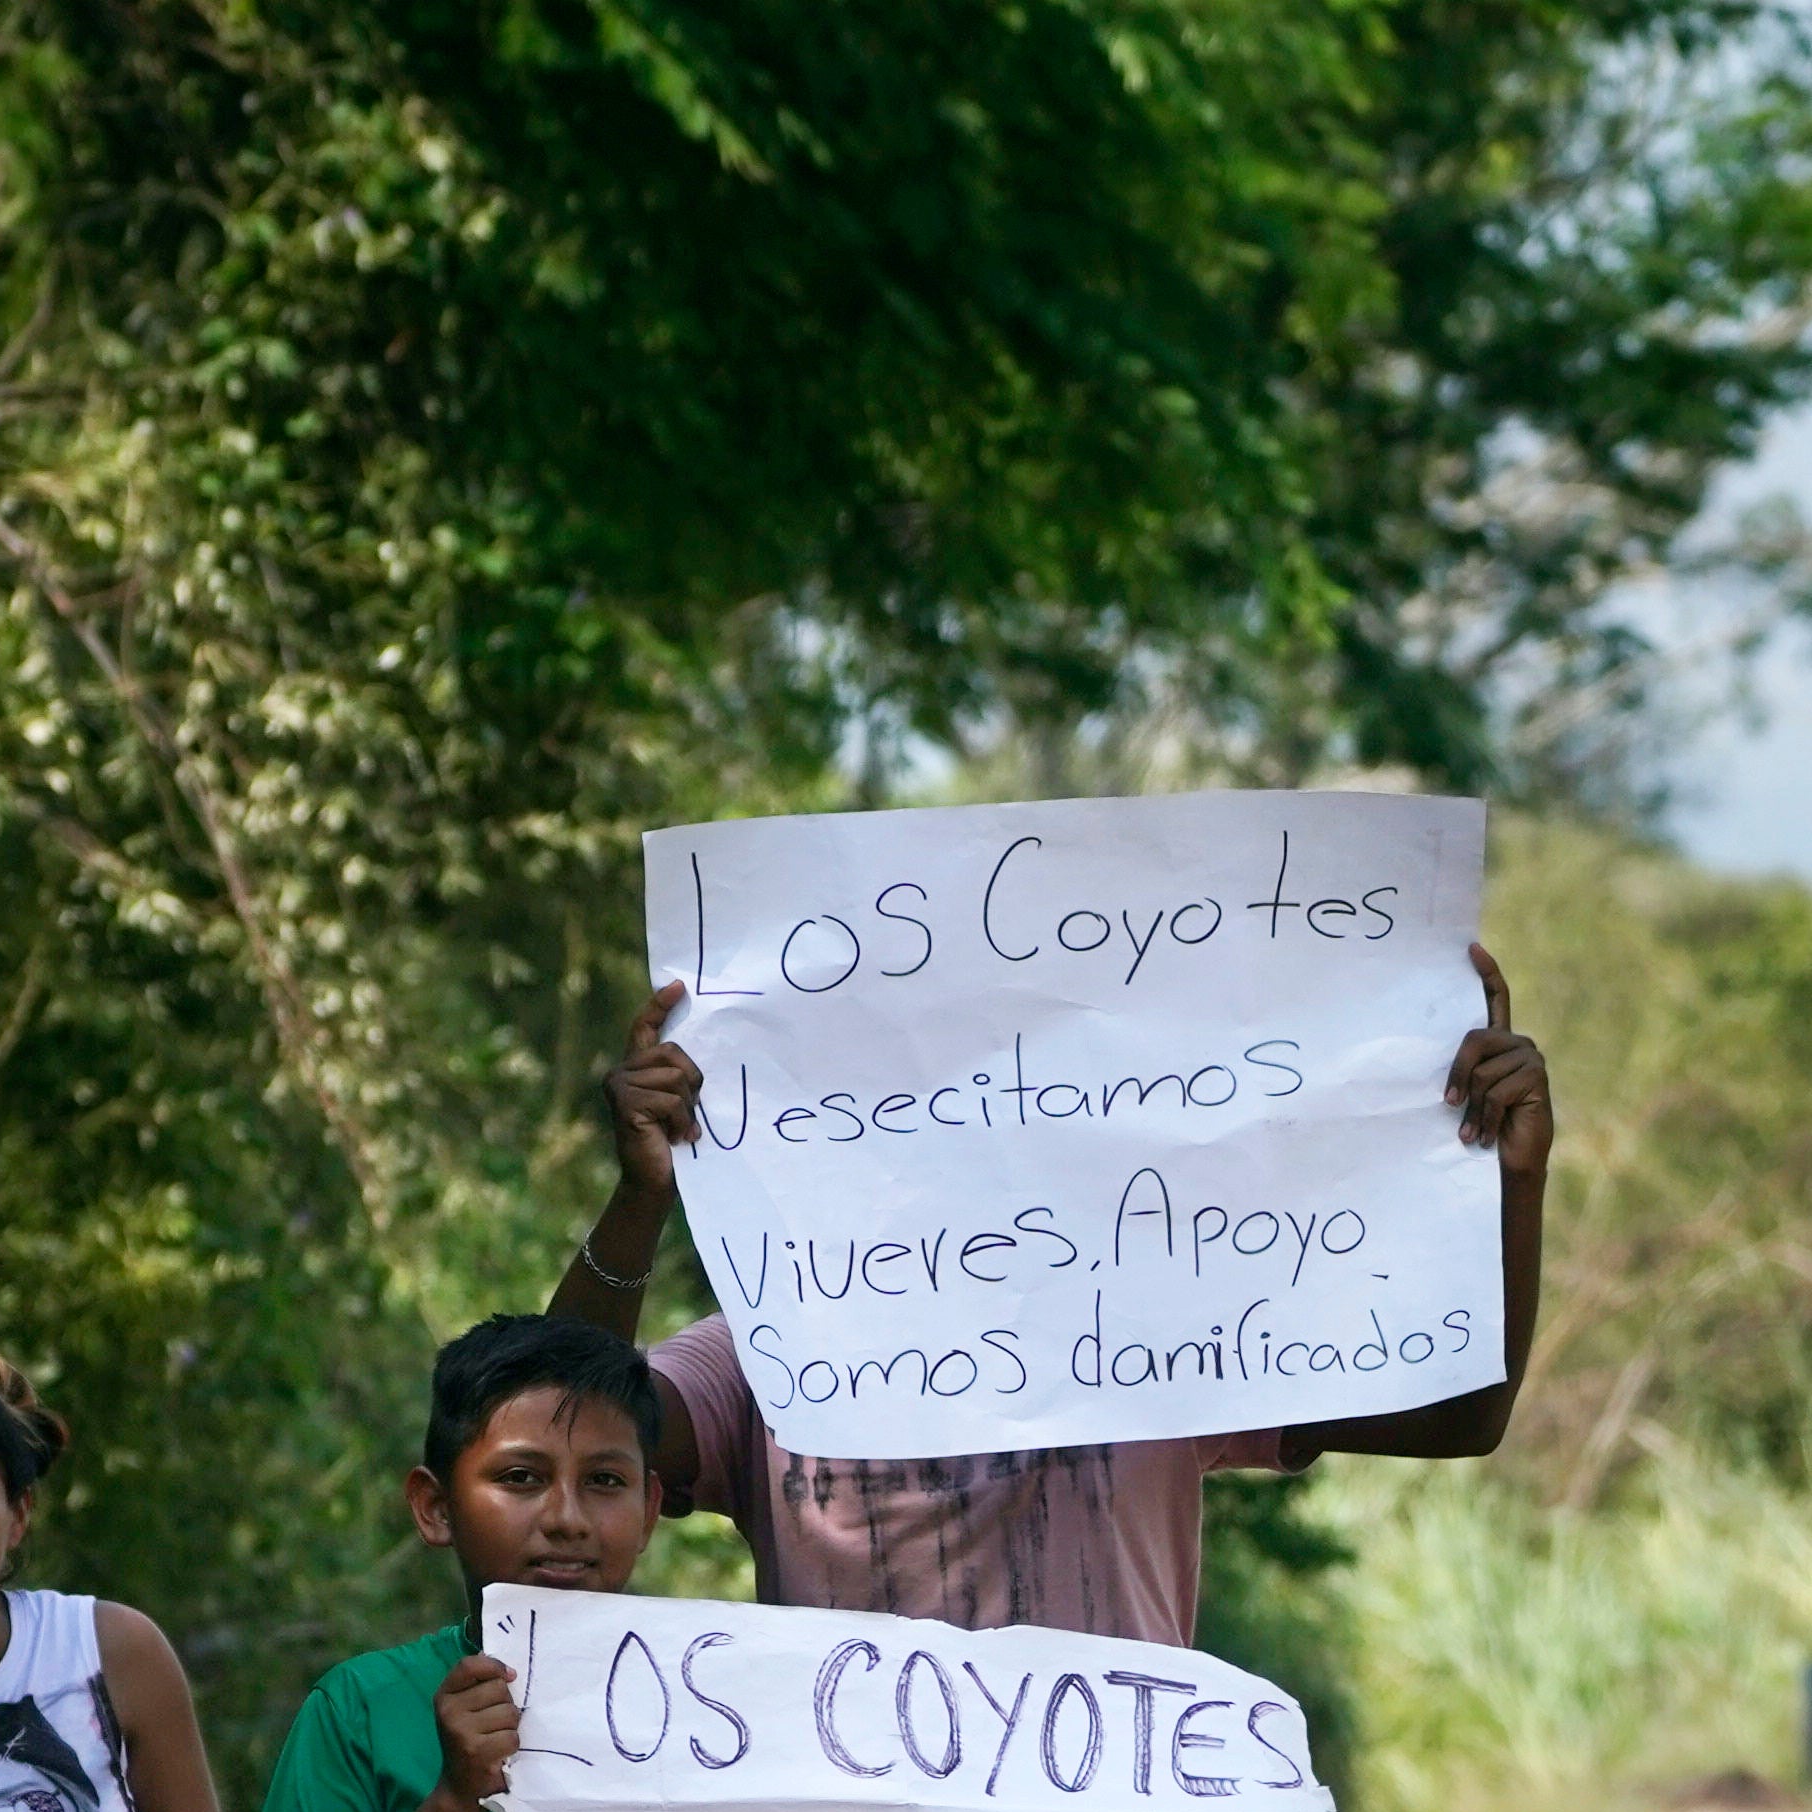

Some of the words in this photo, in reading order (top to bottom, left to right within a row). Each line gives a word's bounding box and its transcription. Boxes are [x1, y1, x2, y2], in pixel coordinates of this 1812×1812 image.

[690, 851, 933, 994] Los
[984, 830, 1399, 986] Coyotes
[749, 1323, 1027, 1409] Somos
[812, 1638, 1305, 1798] COYOTES
